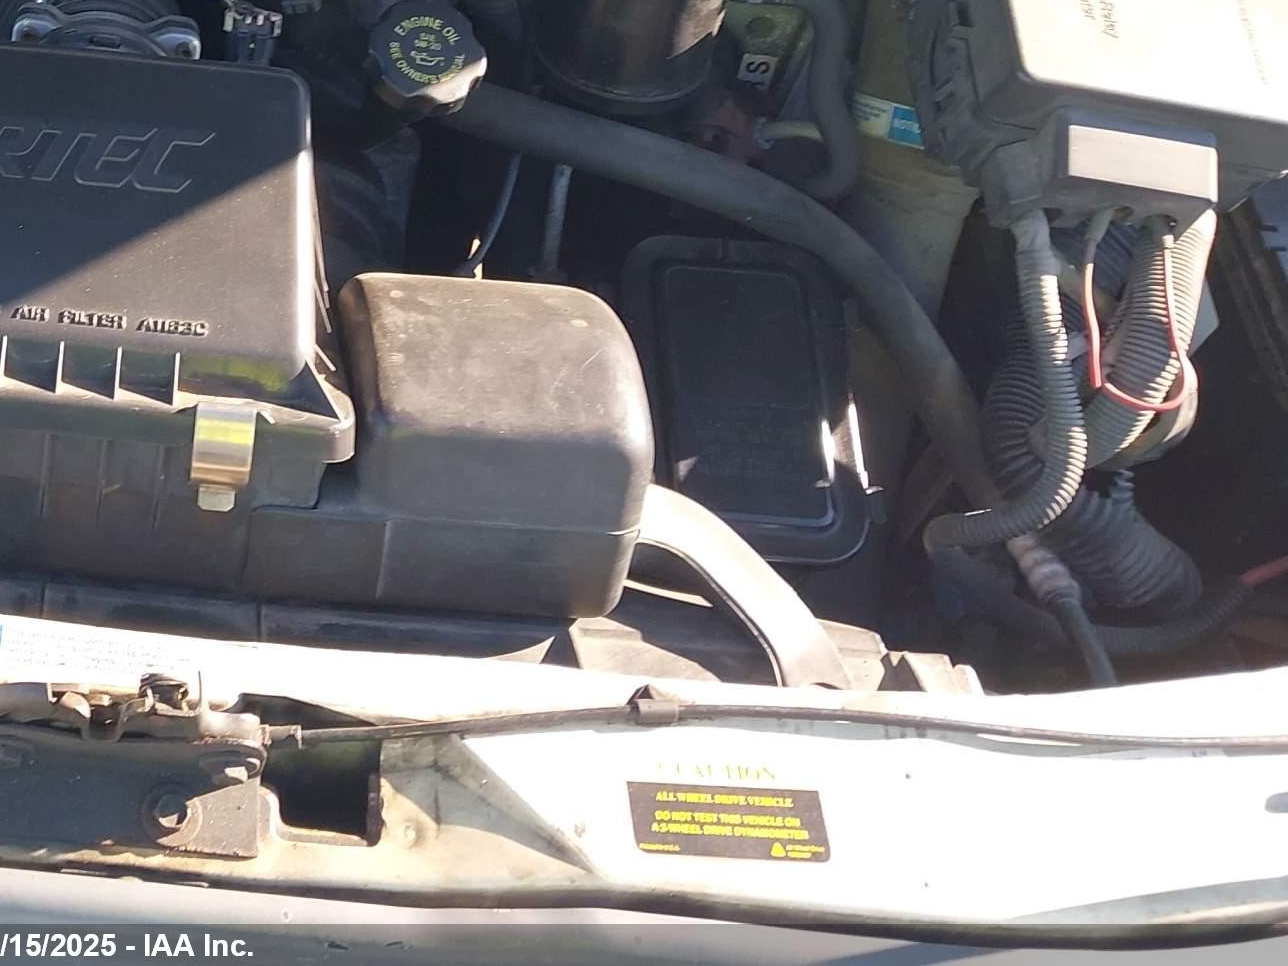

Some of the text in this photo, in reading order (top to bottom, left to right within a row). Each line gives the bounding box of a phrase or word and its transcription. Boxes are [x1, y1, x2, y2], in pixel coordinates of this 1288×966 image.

[393, 15, 462, 45] ENGINE OIL
[11, 304, 49, 323] AIR
[57, 310, 128, 331] FILTER
[655, 790, 794, 808] ALL WHEEL DRIVE VEHICLE
[654, 810, 801, 828] DO NOT TEST THIS VEHICLE ON
[703, 825, 733, 836] DRIVE
[733, 827, 810, 840] DYNAMOMETER
